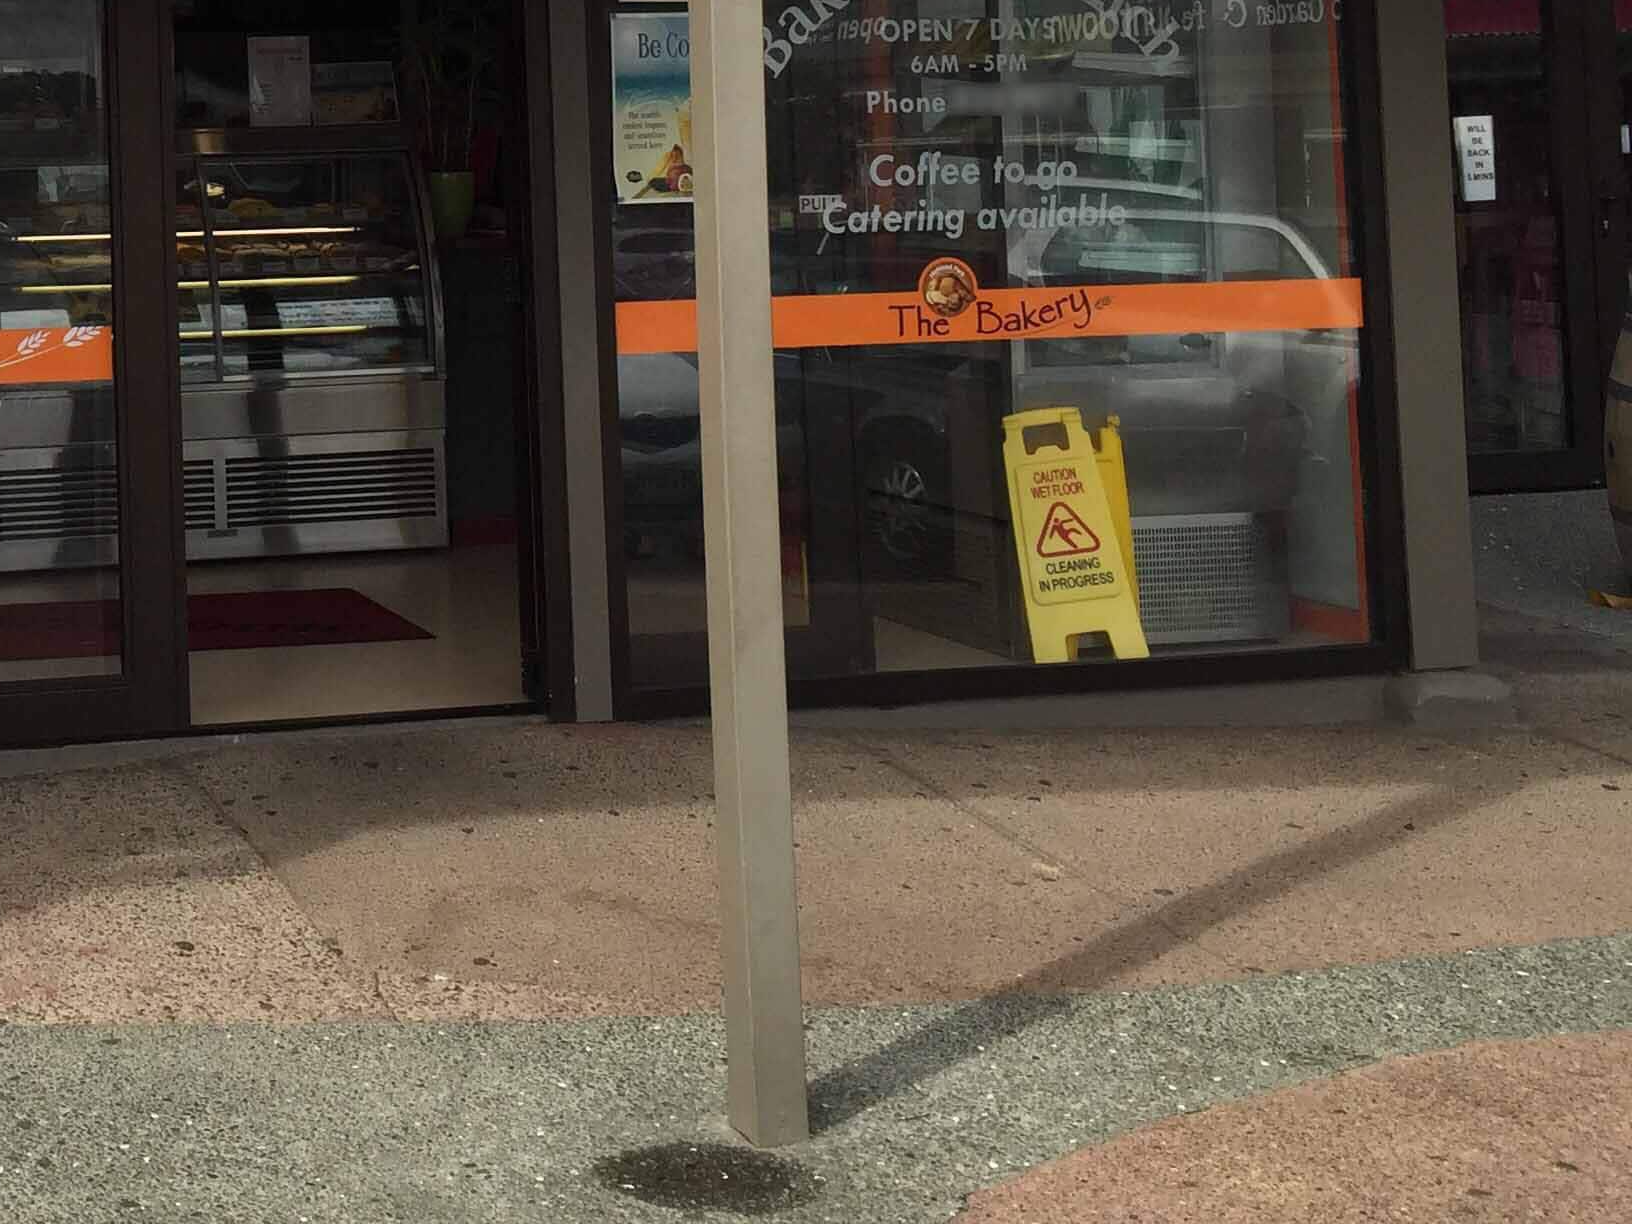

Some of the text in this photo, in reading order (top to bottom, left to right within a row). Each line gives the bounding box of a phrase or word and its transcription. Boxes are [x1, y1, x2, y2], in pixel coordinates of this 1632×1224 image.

[880, 18, 953, 43] OPEN
[964, 18, 983, 42] 7
[990, 16, 1056, 41] DAYS
[638, 31, 690, 59] Be Co
[910, 53, 960, 74] 6AM
[983, 53, 1028, 73] 5PM
[867, 90, 947, 114] Phone
[1466, 125, 1487, 133] WILL
[869, 151, 1079, 190] Coffee to go
[801, 197, 841, 211] PUL
[821, 192, 1128, 240] Catering available
[888, 288, 1092, 338] The Bakery
[1032, 467, 1077, 484] CAUTION
[1030, 481, 1085, 499] WET FLOOR
[1045, 557, 1101, 575] CLEANING
[1039, 571, 1115, 593] IN PROGRESS
